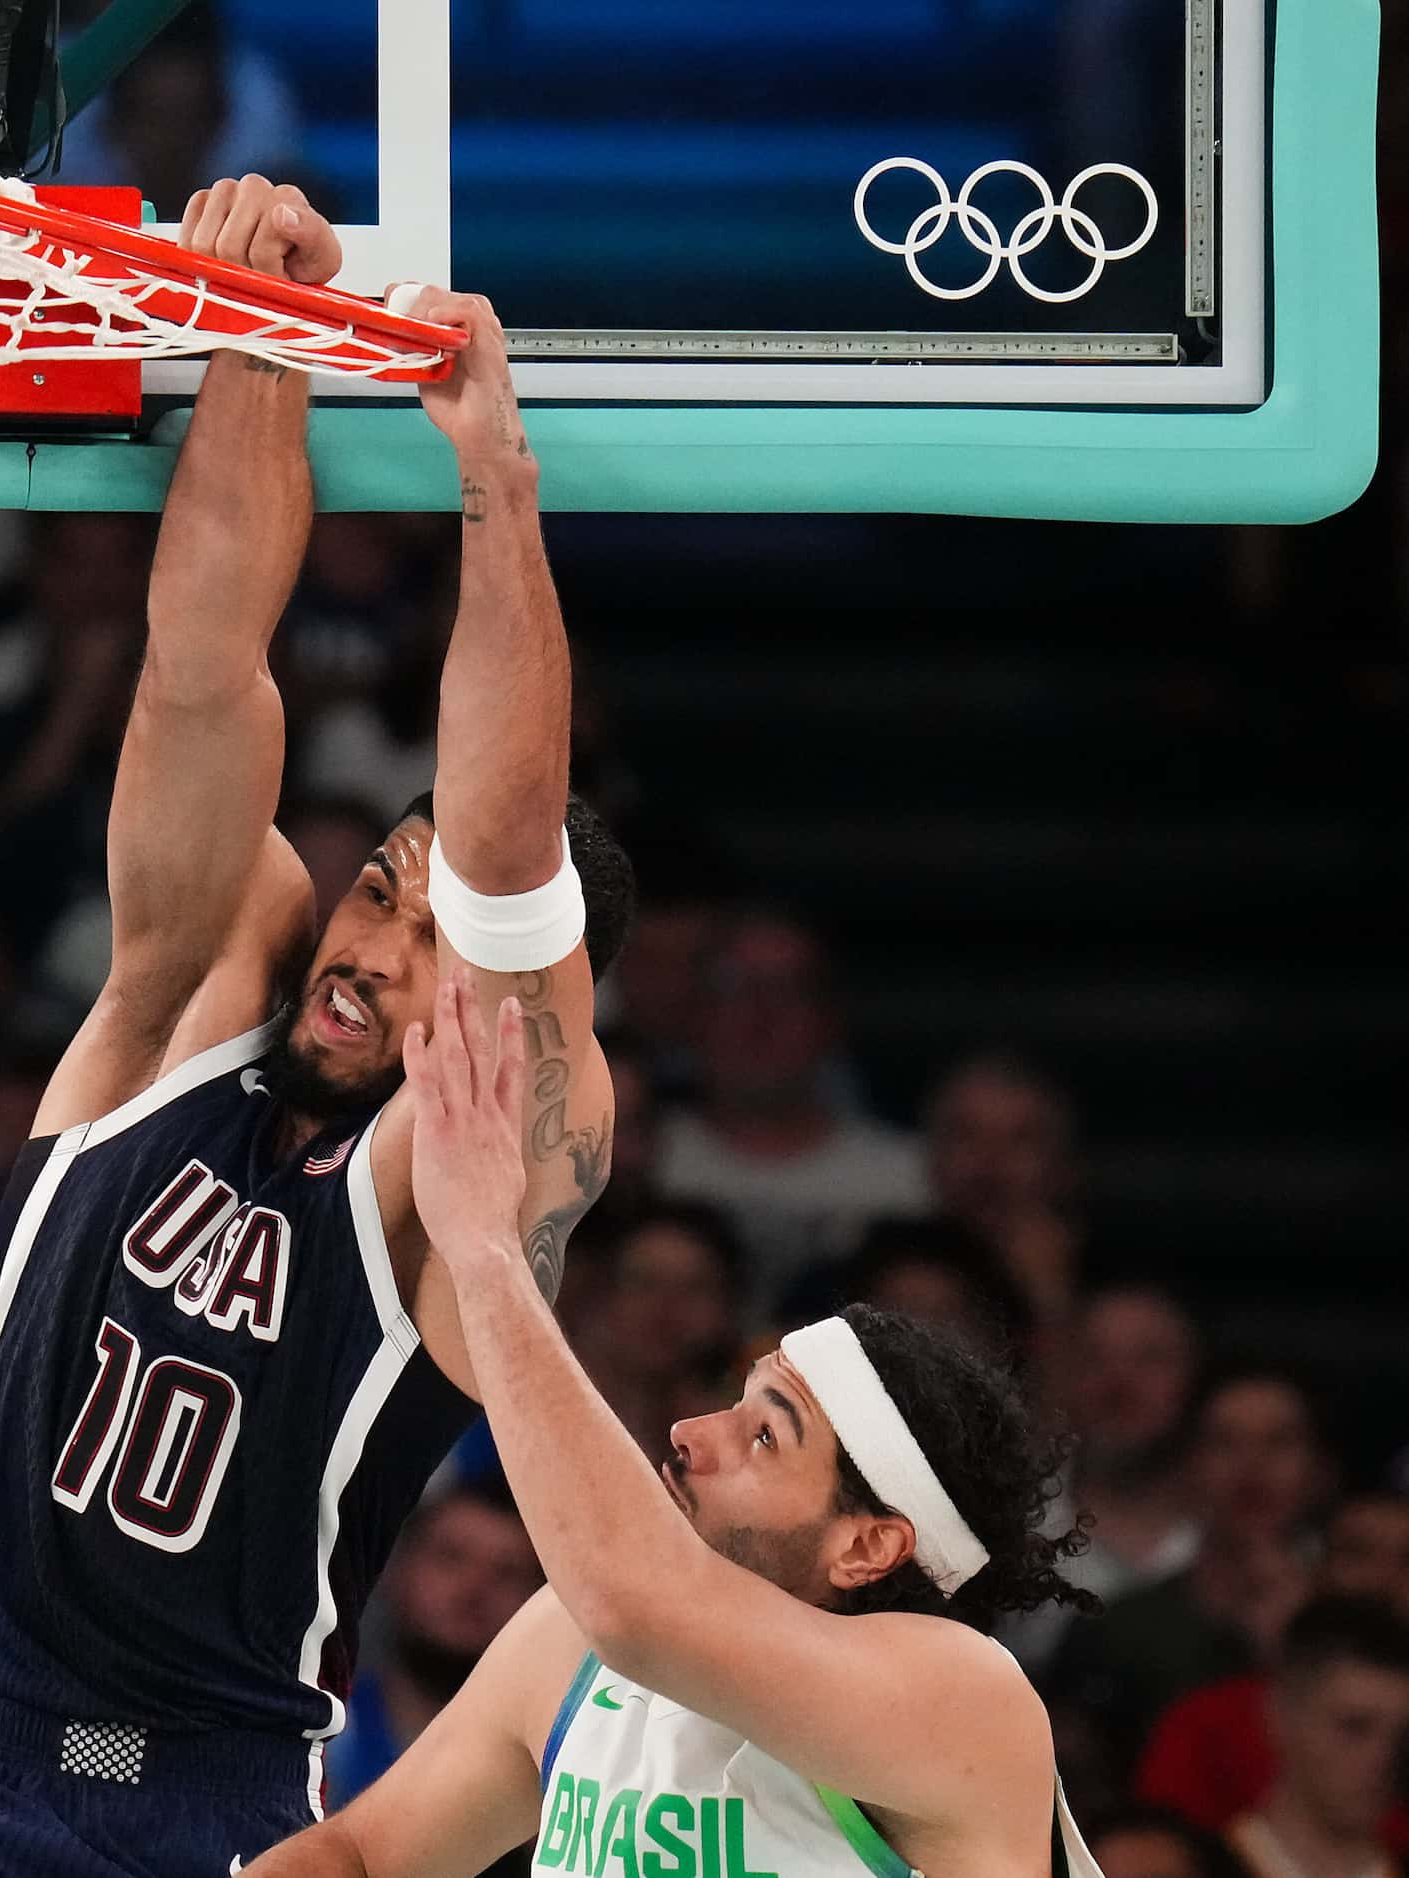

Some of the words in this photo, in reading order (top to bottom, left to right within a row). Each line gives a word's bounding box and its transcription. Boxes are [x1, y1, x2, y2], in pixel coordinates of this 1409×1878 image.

[122, 1158, 291, 1342] USA
[51, 1316, 242, 1553] 10
[537, 1771, 779, 1878] BRASIL
